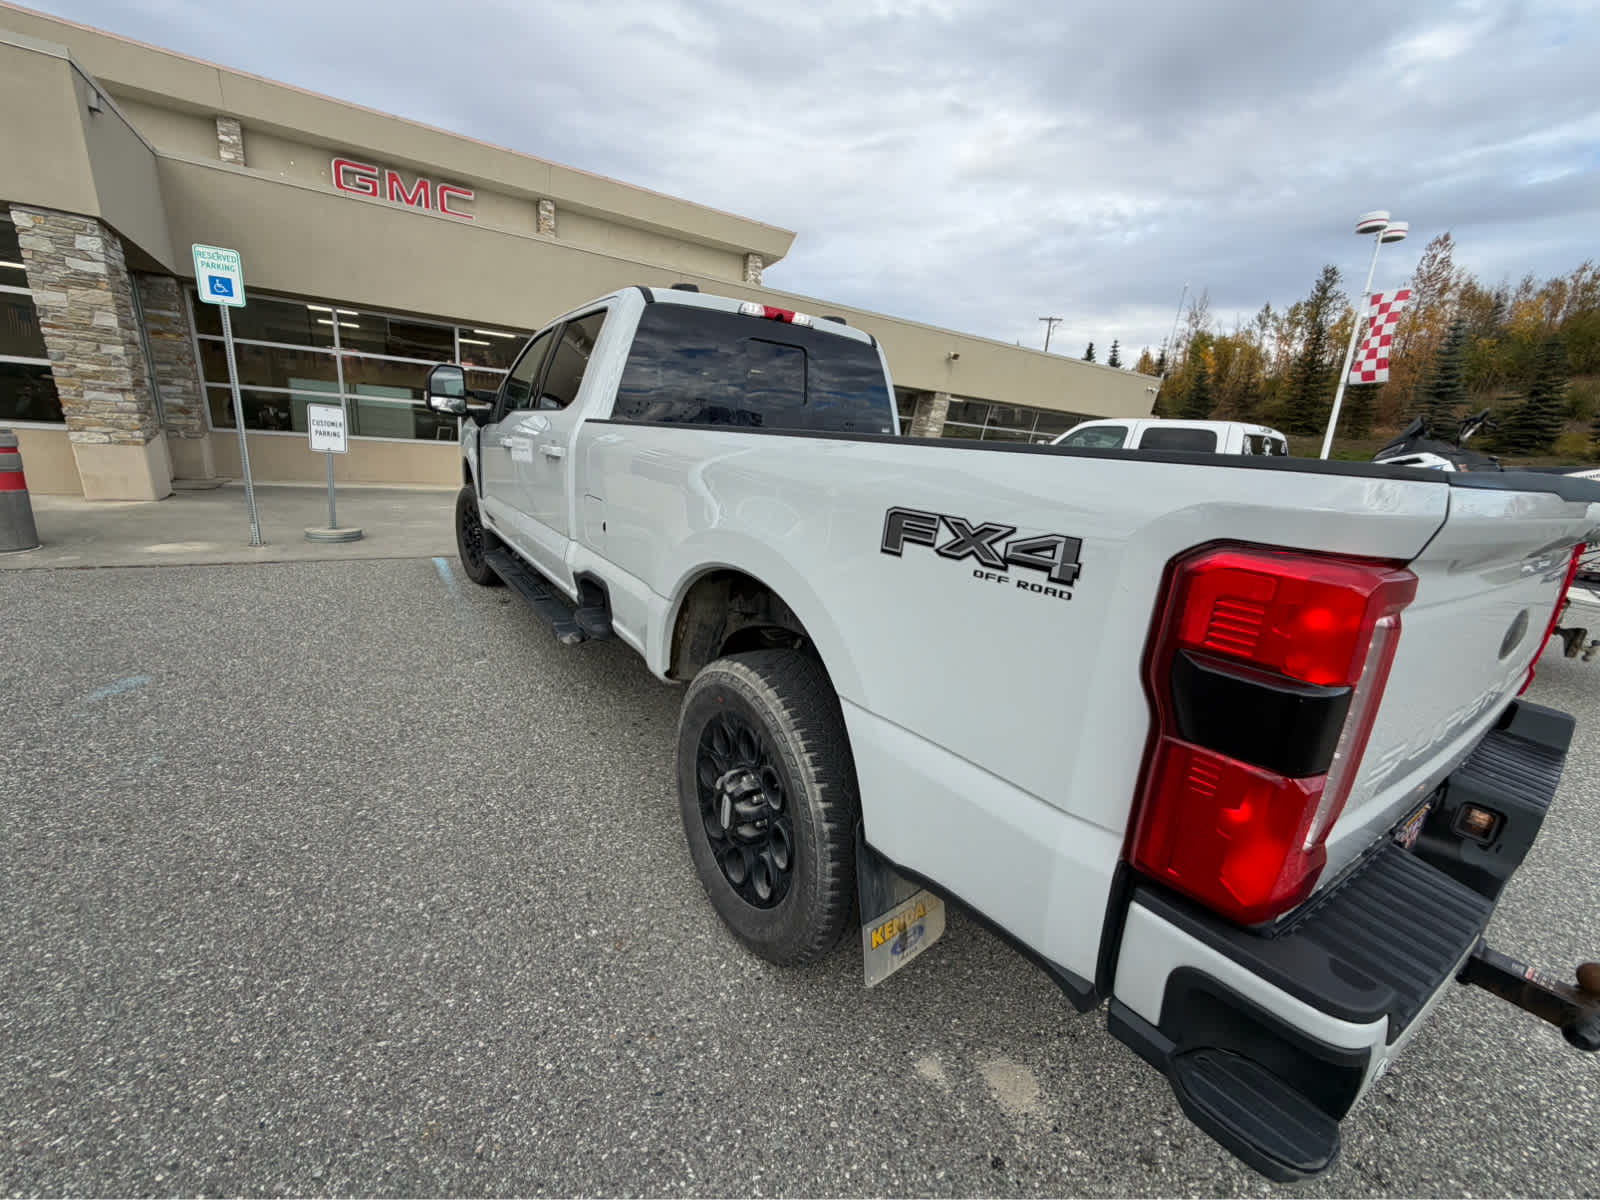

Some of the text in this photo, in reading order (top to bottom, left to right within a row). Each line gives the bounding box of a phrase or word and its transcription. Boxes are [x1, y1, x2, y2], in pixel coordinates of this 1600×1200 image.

[331, 157, 475, 221] GMC
[195, 250, 237, 263] RESERVED
[201, 260, 236, 272] PARKING
[311, 419, 343, 428] CUSTOMER
[314, 429, 341, 438] PARKING
[880, 506, 1084, 588] FX4
[972, 569, 1073, 601] OFF ROAD
